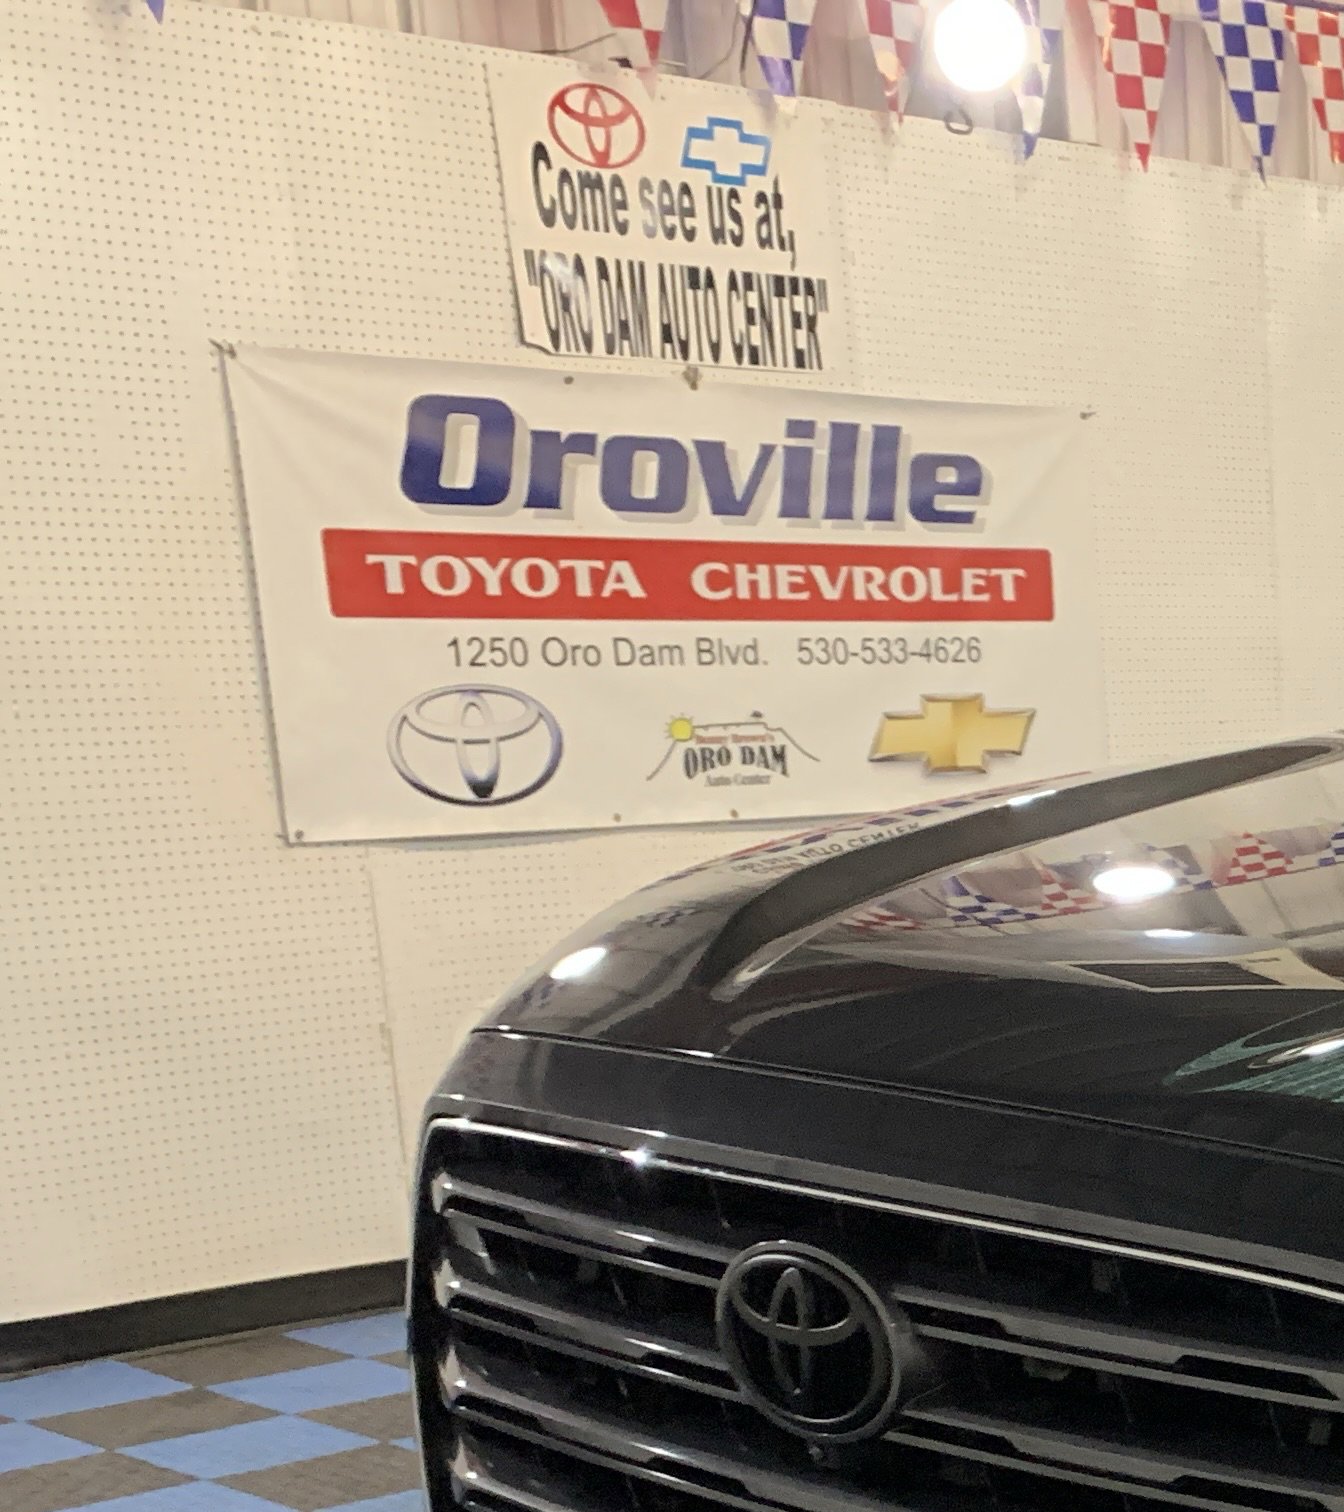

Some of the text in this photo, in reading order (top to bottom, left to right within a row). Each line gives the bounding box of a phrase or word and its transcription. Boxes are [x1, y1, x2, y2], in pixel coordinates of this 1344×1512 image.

[531, 140, 797, 271] Come see us at,
[596, 255, 653, 359] DAM
[657, 262, 722, 364] AUTO
[727, 268, 829, 370] CENTER"
[400, 393, 984, 525] Oroville
[365, 553, 1028, 603] TOYOTA CHEVROLET
[446, 635, 983, 669] 1250 Oro Dam Blvd. 530-533-4626
[683, 743, 790, 780] ORO DAM
